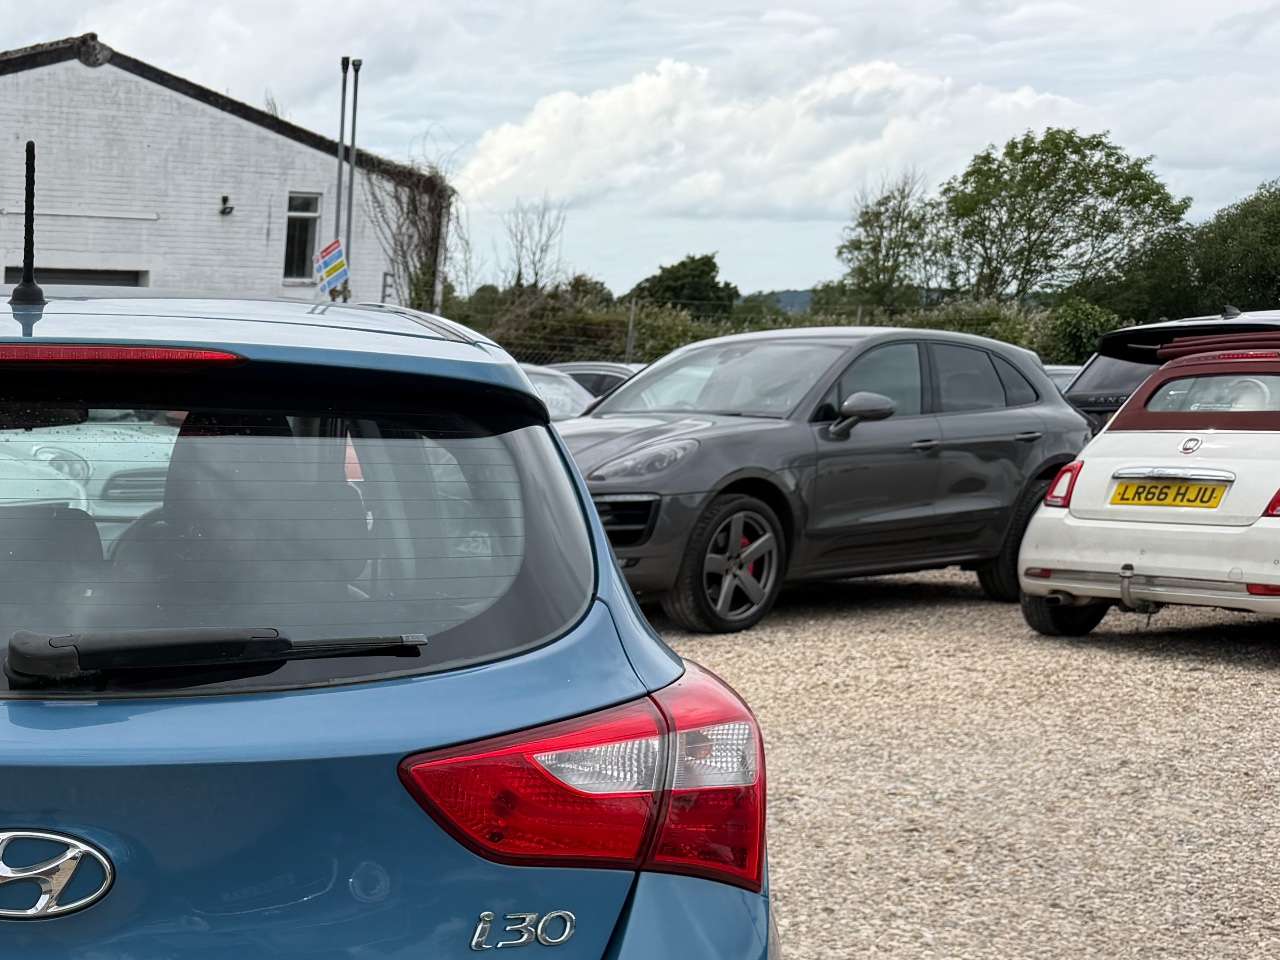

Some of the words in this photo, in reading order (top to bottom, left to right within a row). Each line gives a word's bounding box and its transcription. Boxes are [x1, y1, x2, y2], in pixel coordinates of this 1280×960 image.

[1120, 484, 1170, 501] LR66
[1172, 485, 1217, 503] HJU
[470, 910, 576, 951] i30
